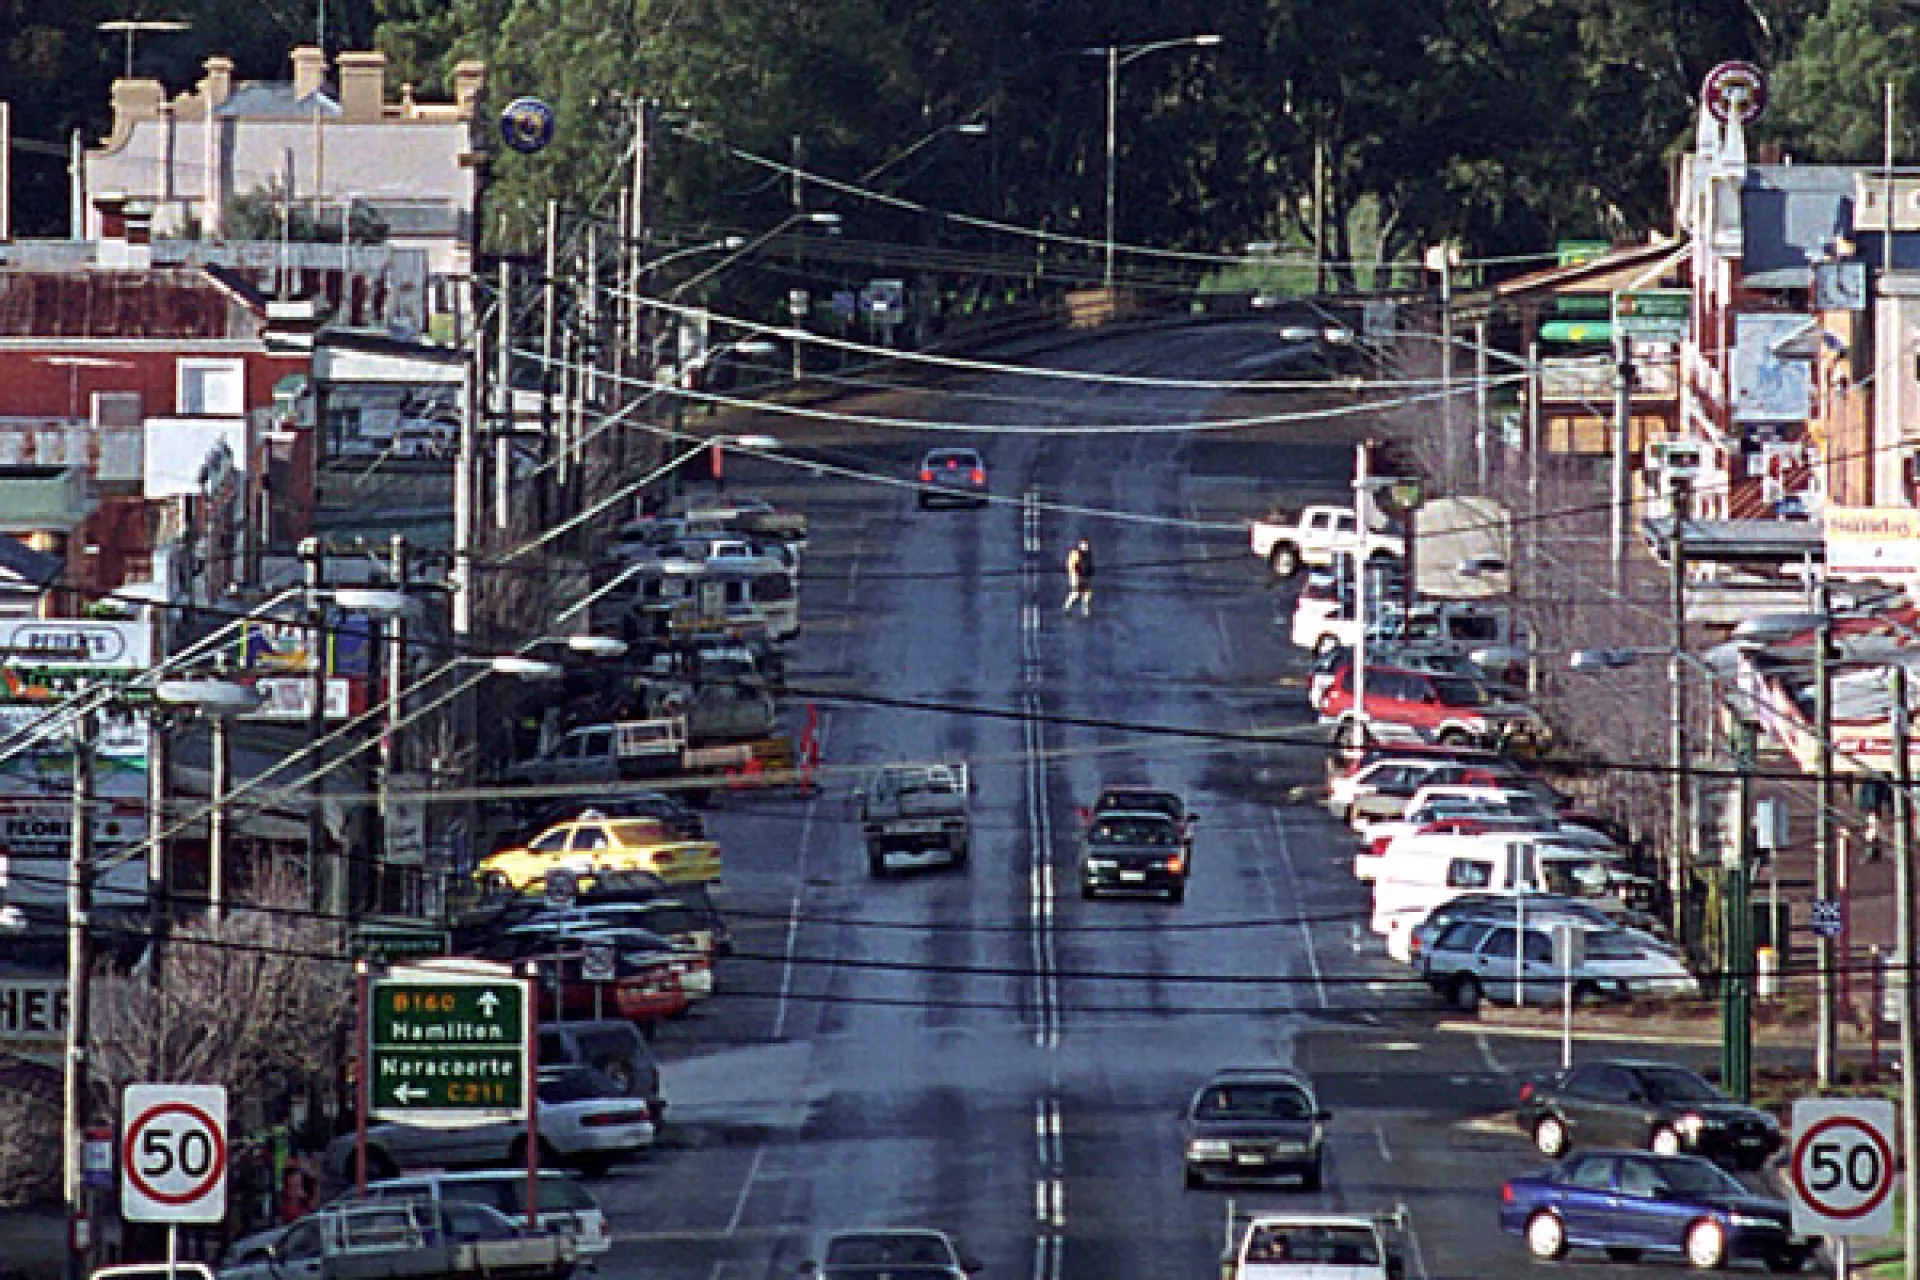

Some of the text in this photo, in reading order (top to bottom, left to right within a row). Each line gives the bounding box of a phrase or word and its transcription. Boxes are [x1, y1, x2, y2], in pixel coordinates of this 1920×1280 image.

[393, 991, 456, 1012] B160
[390, 1021, 503, 1041] Hamilton
[447, 1083, 504, 1102] C211
[142, 1129, 212, 1178] 50
[1810, 1143, 1879, 1193] 50
